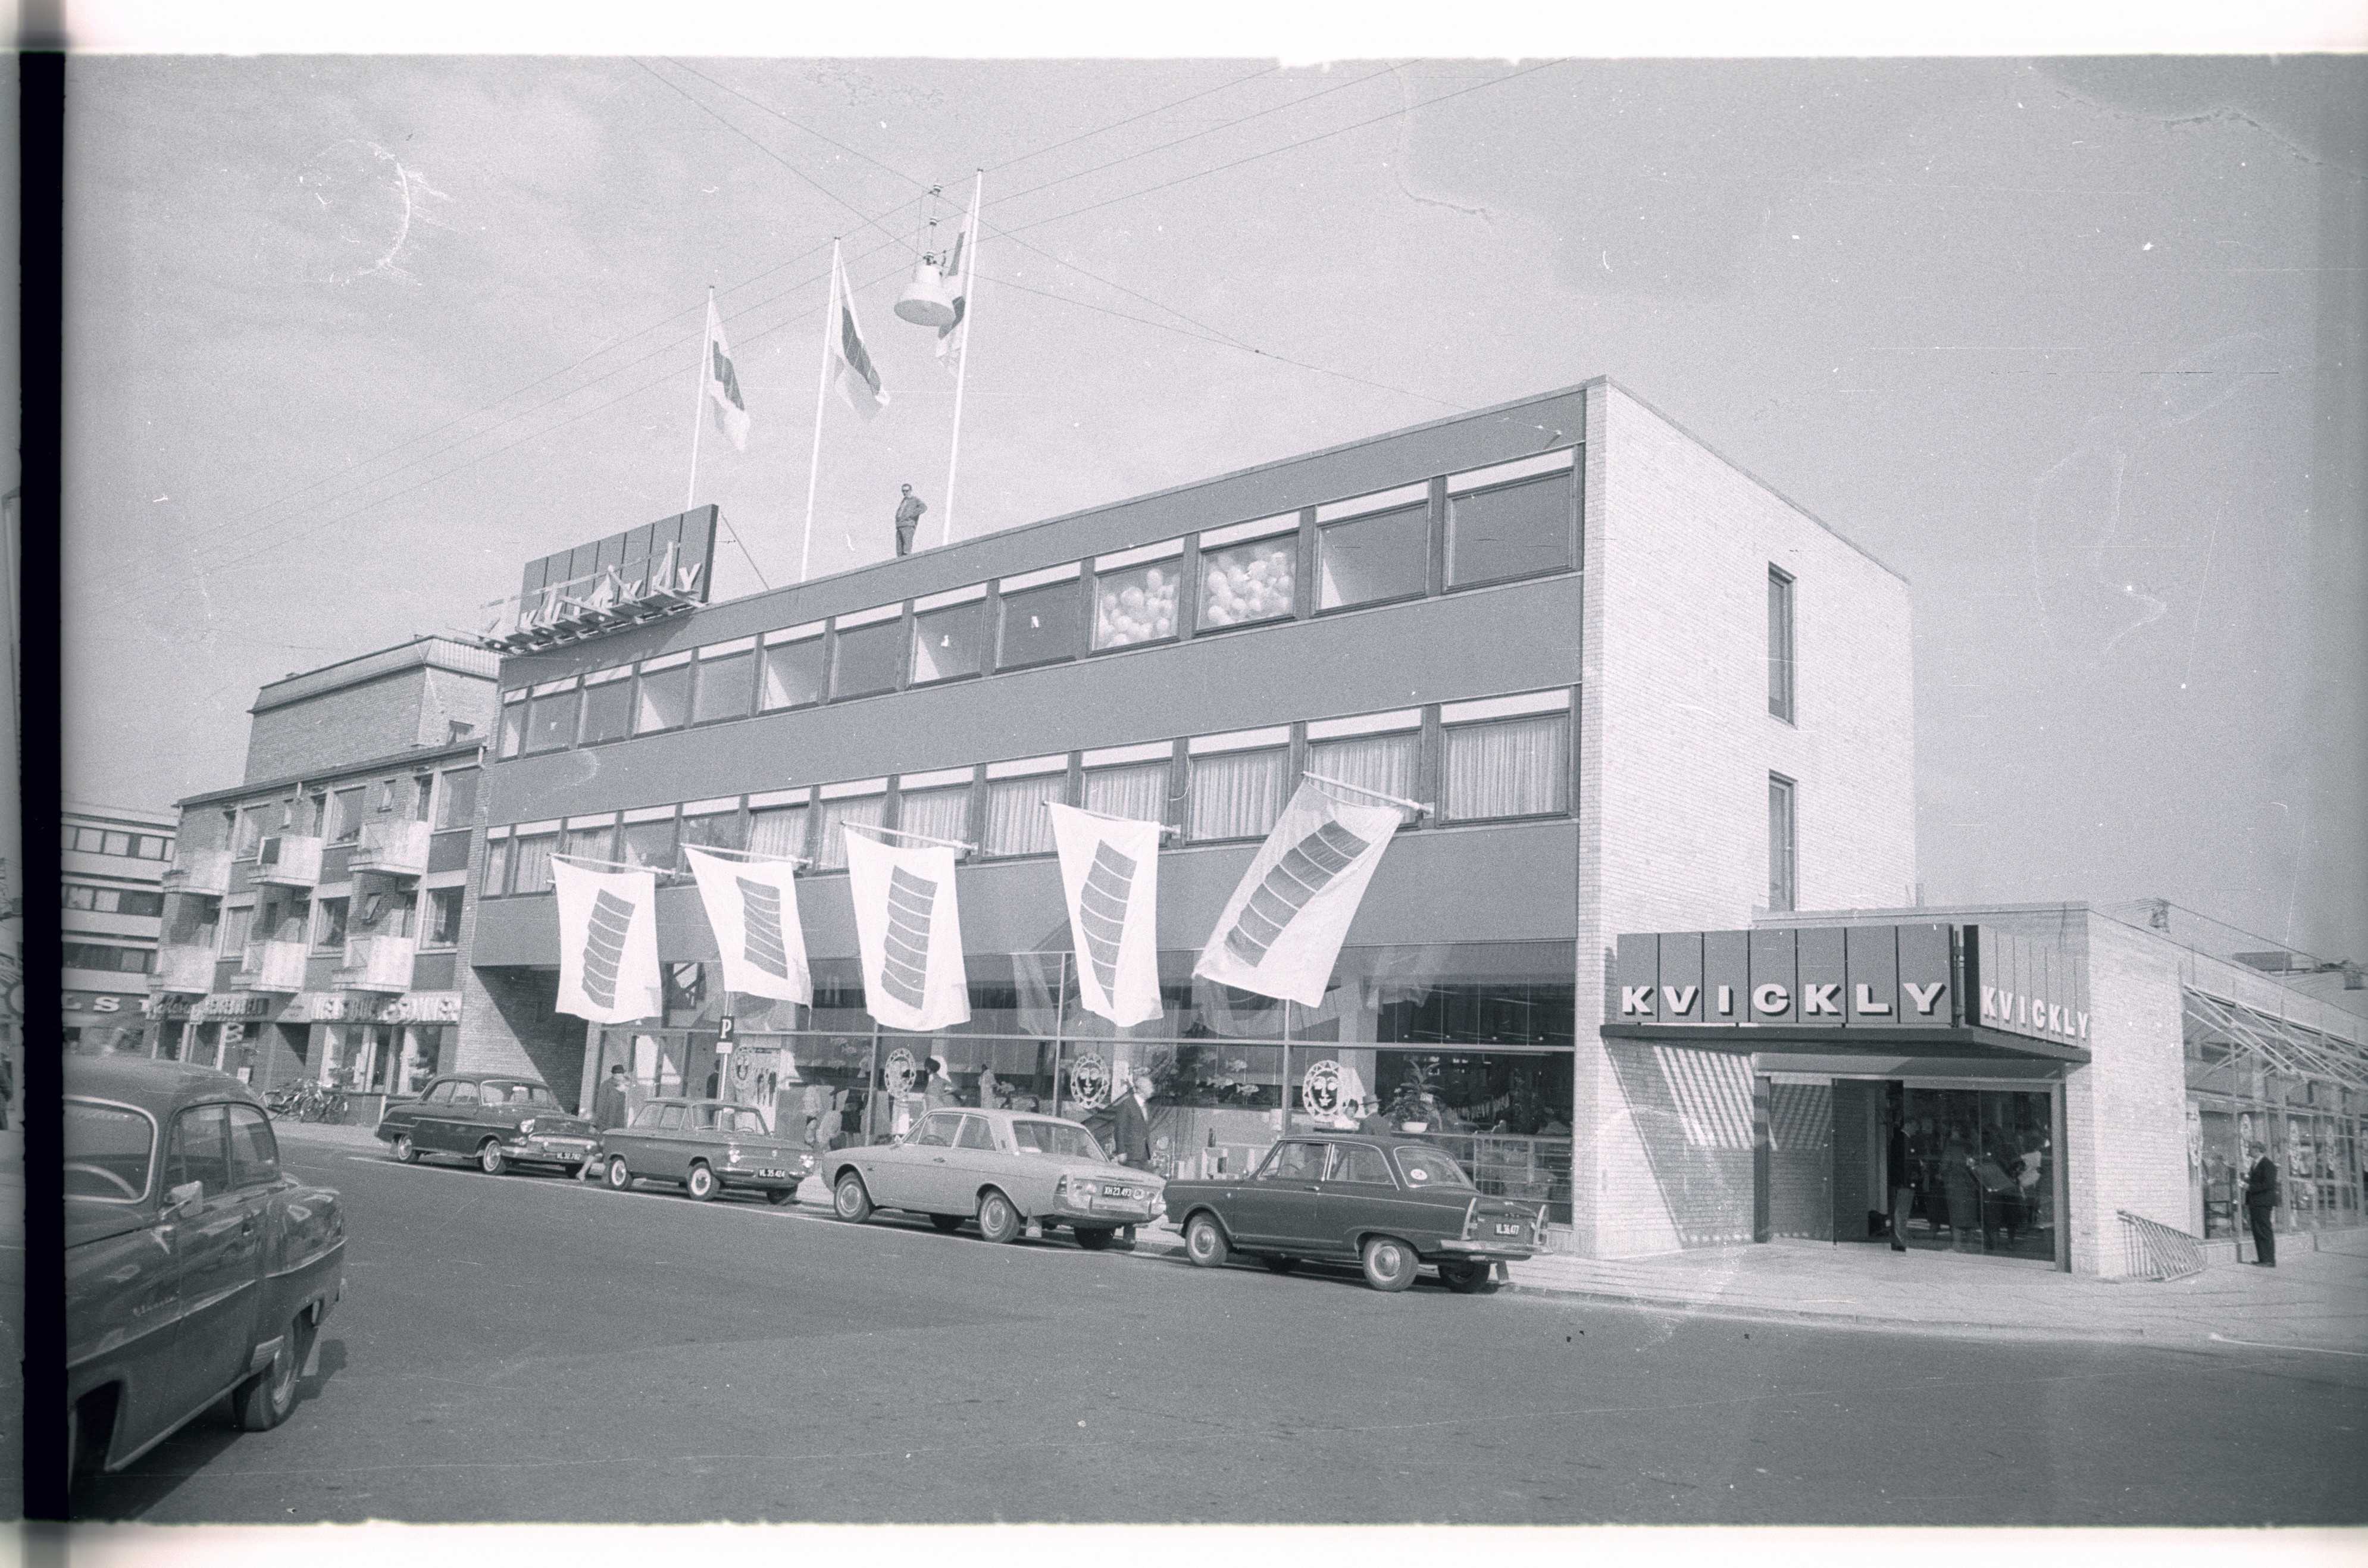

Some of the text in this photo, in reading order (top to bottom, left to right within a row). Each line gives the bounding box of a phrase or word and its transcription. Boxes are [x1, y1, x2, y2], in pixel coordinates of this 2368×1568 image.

[1622, 982, 1944, 1013] KVICKLY
[1980, 985, 2089, 1038] KVICKLY
[720, 1019, 732, 1038] P
